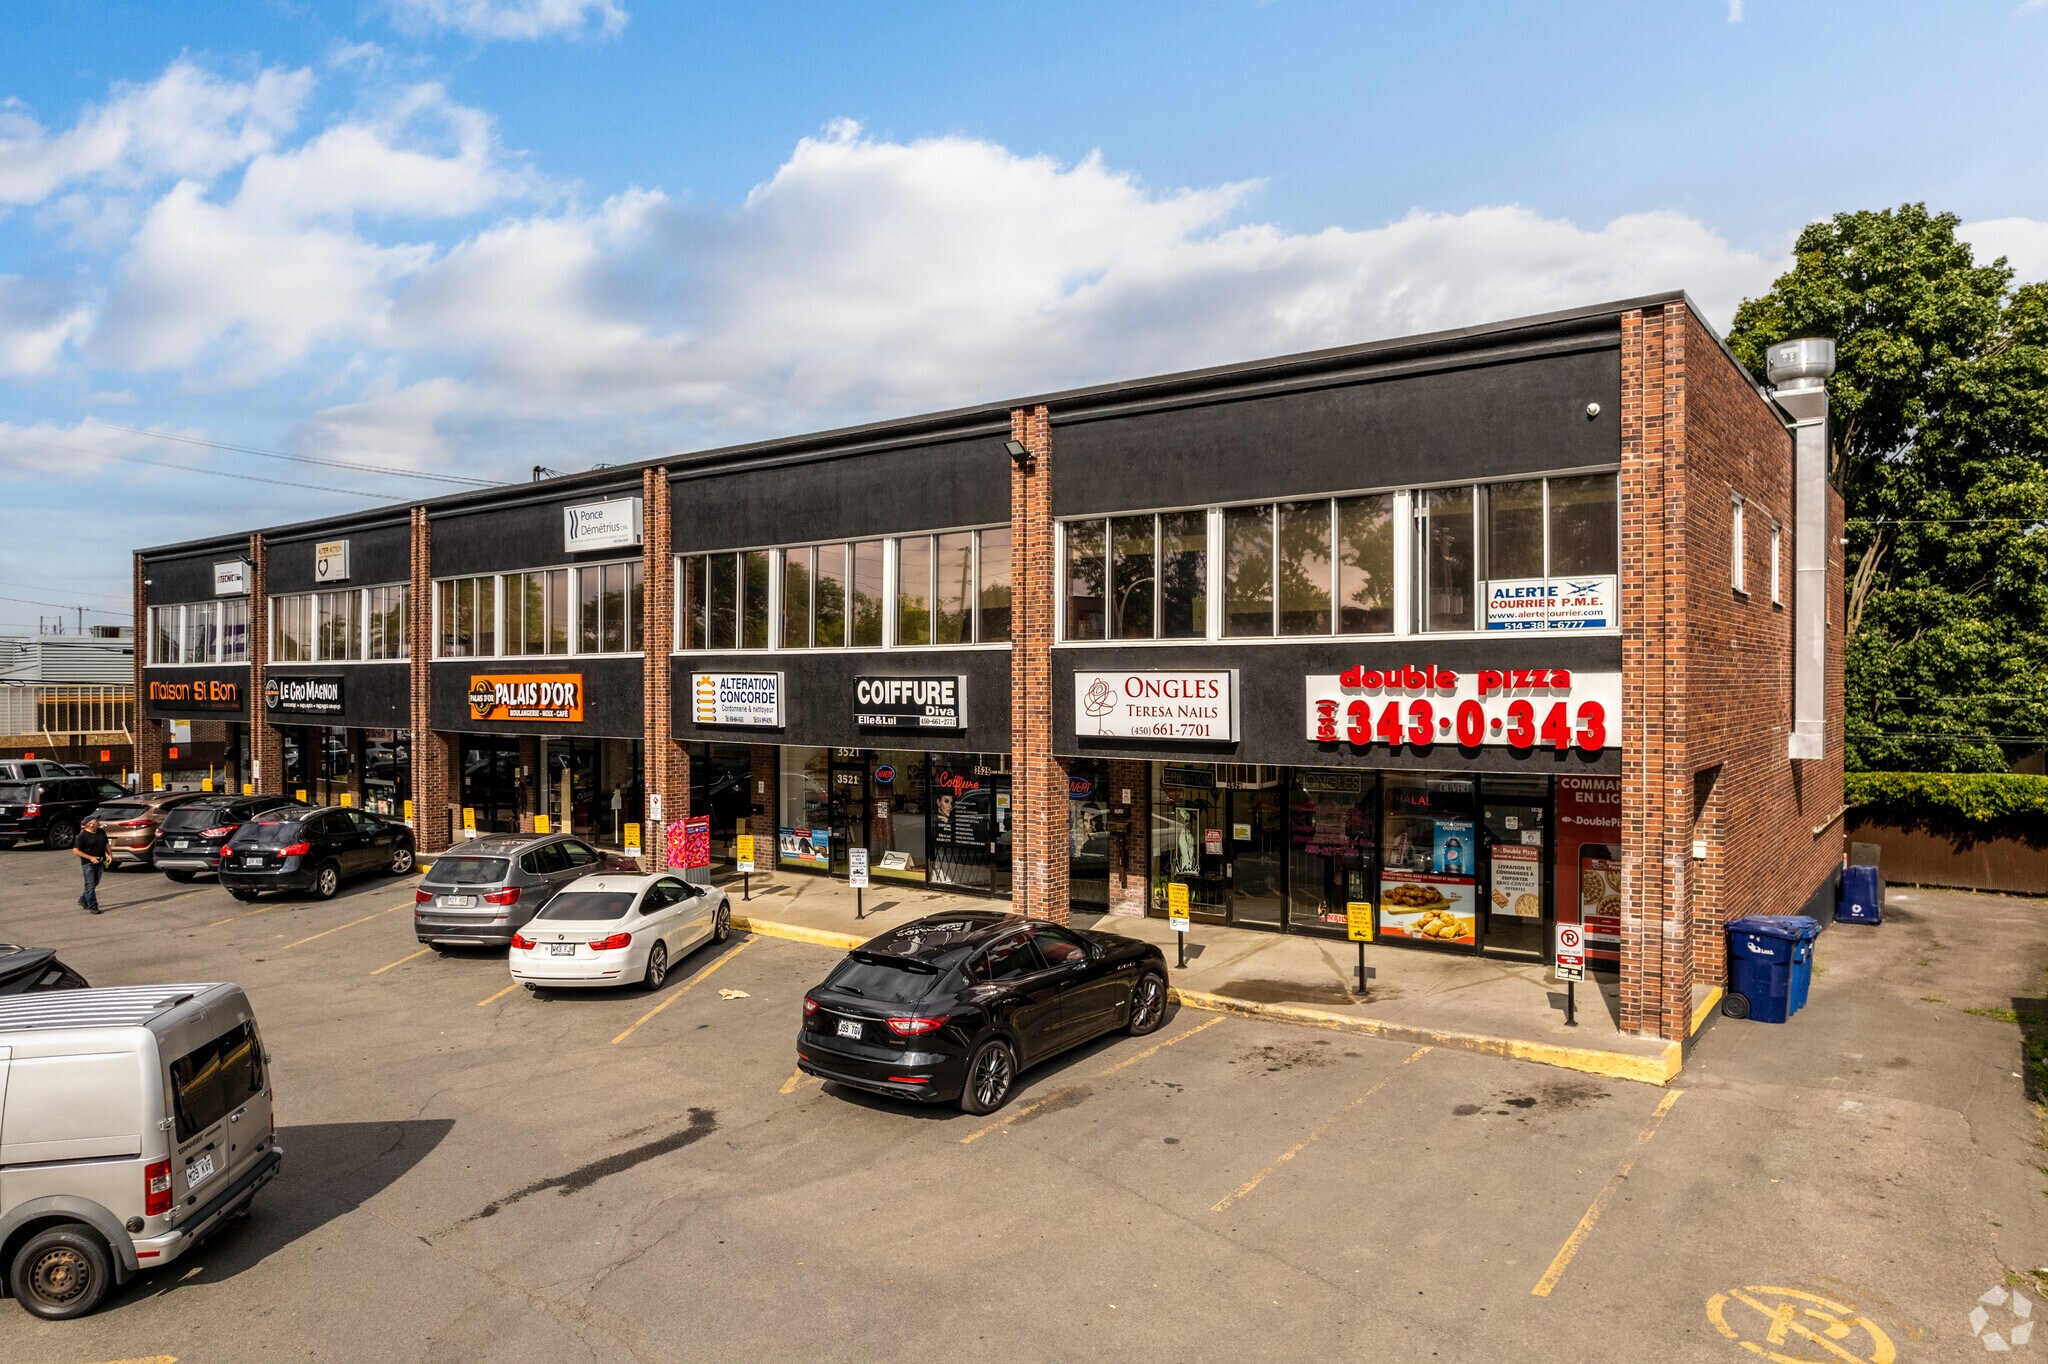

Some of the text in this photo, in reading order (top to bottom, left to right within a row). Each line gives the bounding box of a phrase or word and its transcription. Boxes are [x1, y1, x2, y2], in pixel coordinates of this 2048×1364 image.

[581, 510, 603, 521] Ponce
[581, 522, 620, 535] Démétrius
[1494, 586, 1558, 599] ALERTE
[1490, 597, 1603, 609] COURRIER P.M.E.
[720, 678, 775, 690] ALTERATION
[1339, 664, 1572, 696] double pizza
[150, 680, 236, 701] Maison Si Bon
[280, 681, 338, 701] LE CRO MAGNON
[495, 682, 575, 706] PALAIS D'OR
[857, 680, 955, 705] COIFFURE
[1124, 676, 1219, 699] ONGLES
[470, 694, 483, 702] PALAIS
[720, 691, 775, 704] CONCORDE
[556, 709, 568, 717] CAFÉ
[722, 704, 747, 712] Cordonnerie
[748, 705, 752, 713] &
[925, 705, 955, 716] Diva
[1126, 703, 1218, 719] TERESA NAILS
[1315, 699, 1338, 742] (514)
[1131, 723, 1210, 737] (450) 661-7701
[837, 748, 859, 757] 3521
[837, 774, 859, 785] 3521
[939, 771, 979, 797] Coiffure
[1305, 775, 1360, 790] ONGLES
[1561, 778, 1622, 791] COMMAN
[1440, 783, 1470, 793] OUVERT
[1575, 791, 1621, 804] EN LIG
[1576, 816, 1622, 827] DoublePi
[1175, 857, 1200, 873] Nails
[1496, 869, 1529, 877] COMMANDES
